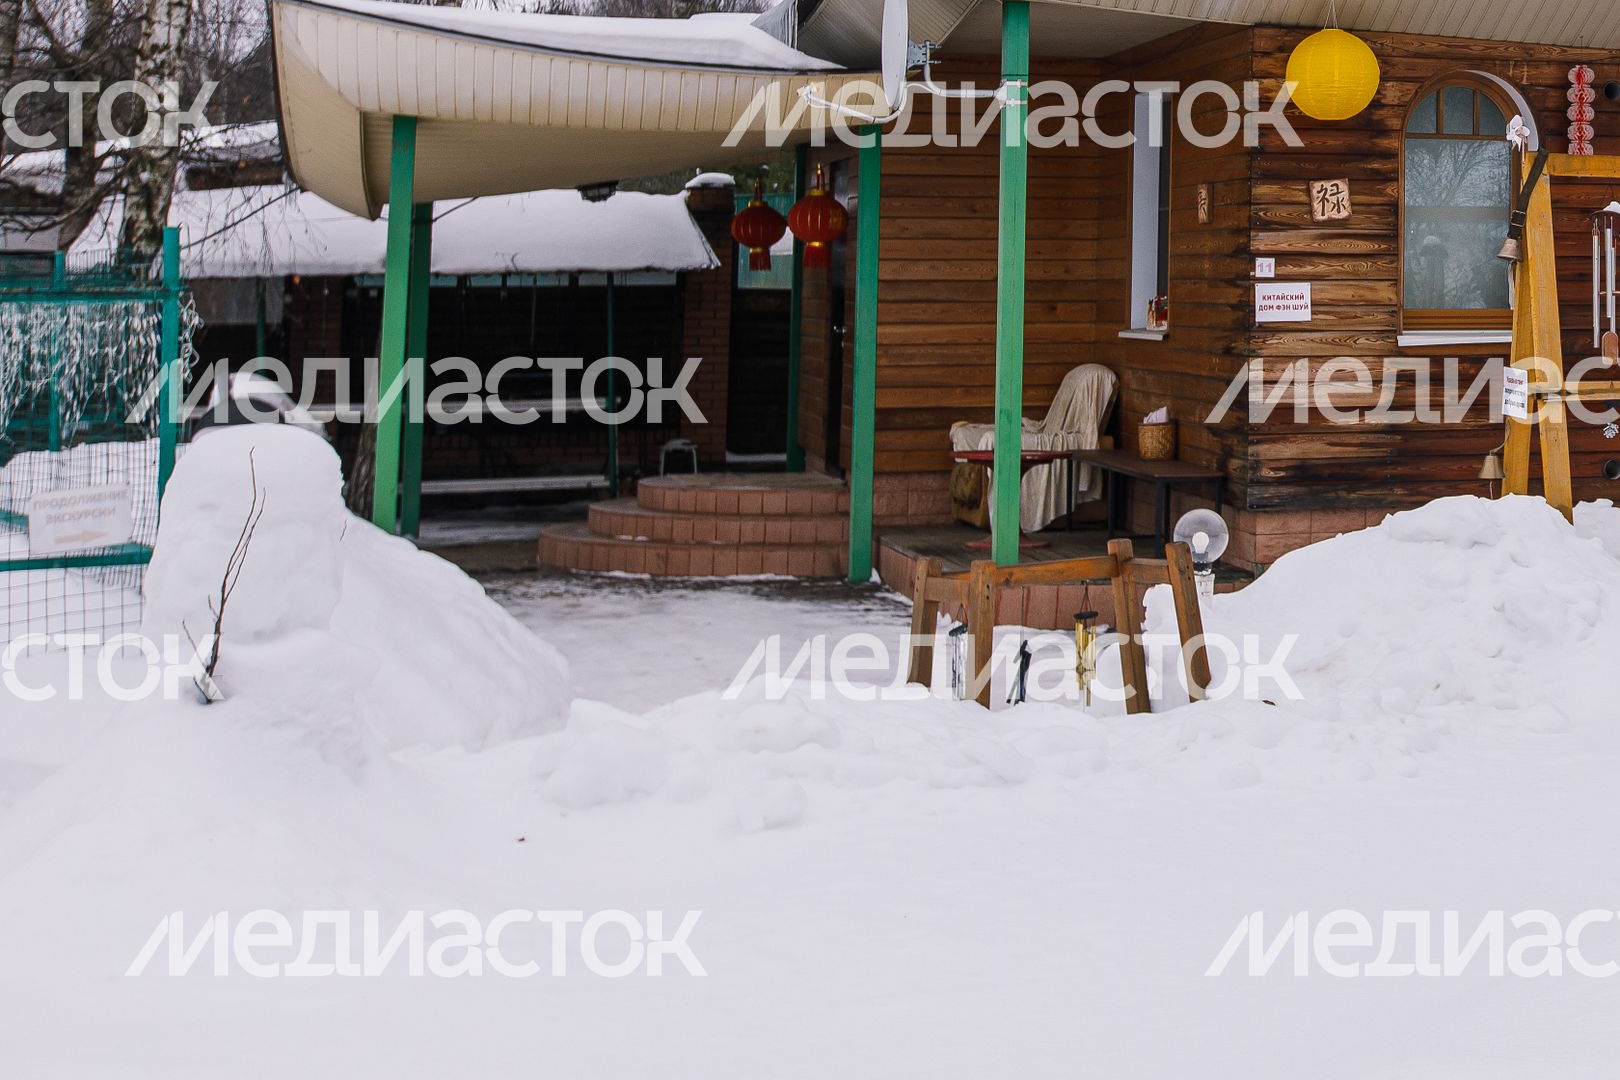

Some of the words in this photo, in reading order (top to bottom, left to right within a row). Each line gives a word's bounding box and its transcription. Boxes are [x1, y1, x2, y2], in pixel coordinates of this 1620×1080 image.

[1258, 262, 1272, 273] 11
[1262, 292, 1305, 301] КИТАЙСКИЙ
[1258, 304, 1275, 312] ДОМ
[1292, 302, 1309, 311] ШУЙ
[33, 489, 128, 510] ПРОДОЛЖЕНИЕ
[45, 505, 117, 525] ЭКСКУРСИИ
